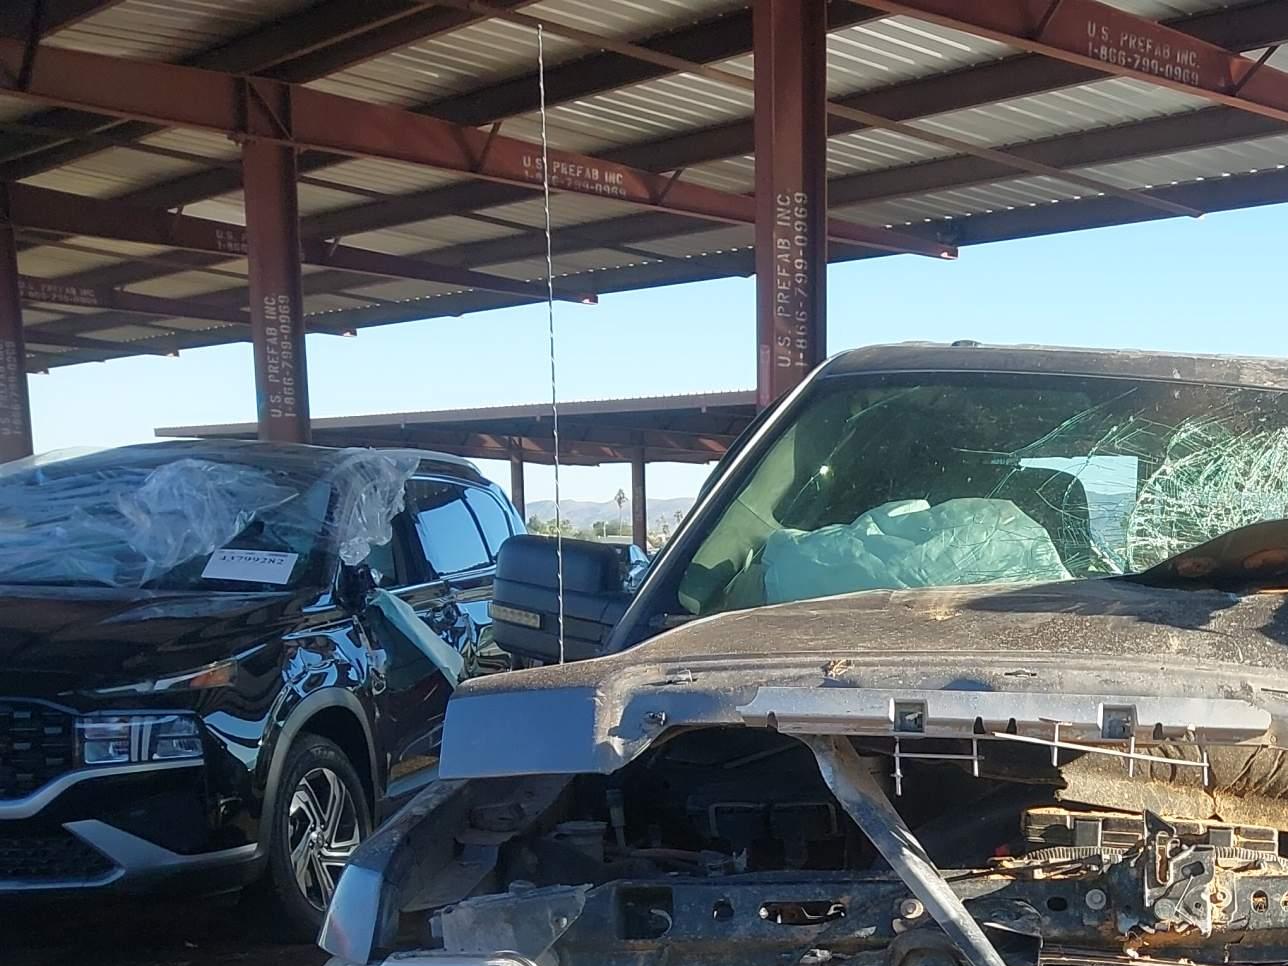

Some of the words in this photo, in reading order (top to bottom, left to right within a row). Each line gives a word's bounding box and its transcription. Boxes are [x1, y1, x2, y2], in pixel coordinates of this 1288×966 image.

[1120, 31, 1170, 59] PREFAB
[552, 161, 600, 180] PREFAB
[776, 237, 792, 318] PREFAB
[793, 192, 808, 368] 1-866-799-0969
[265, 326, 280, 383] PREFAB
[278, 295, 297, 417] 1-866-799-0969
[777, 330, 792, 368] U.S.
